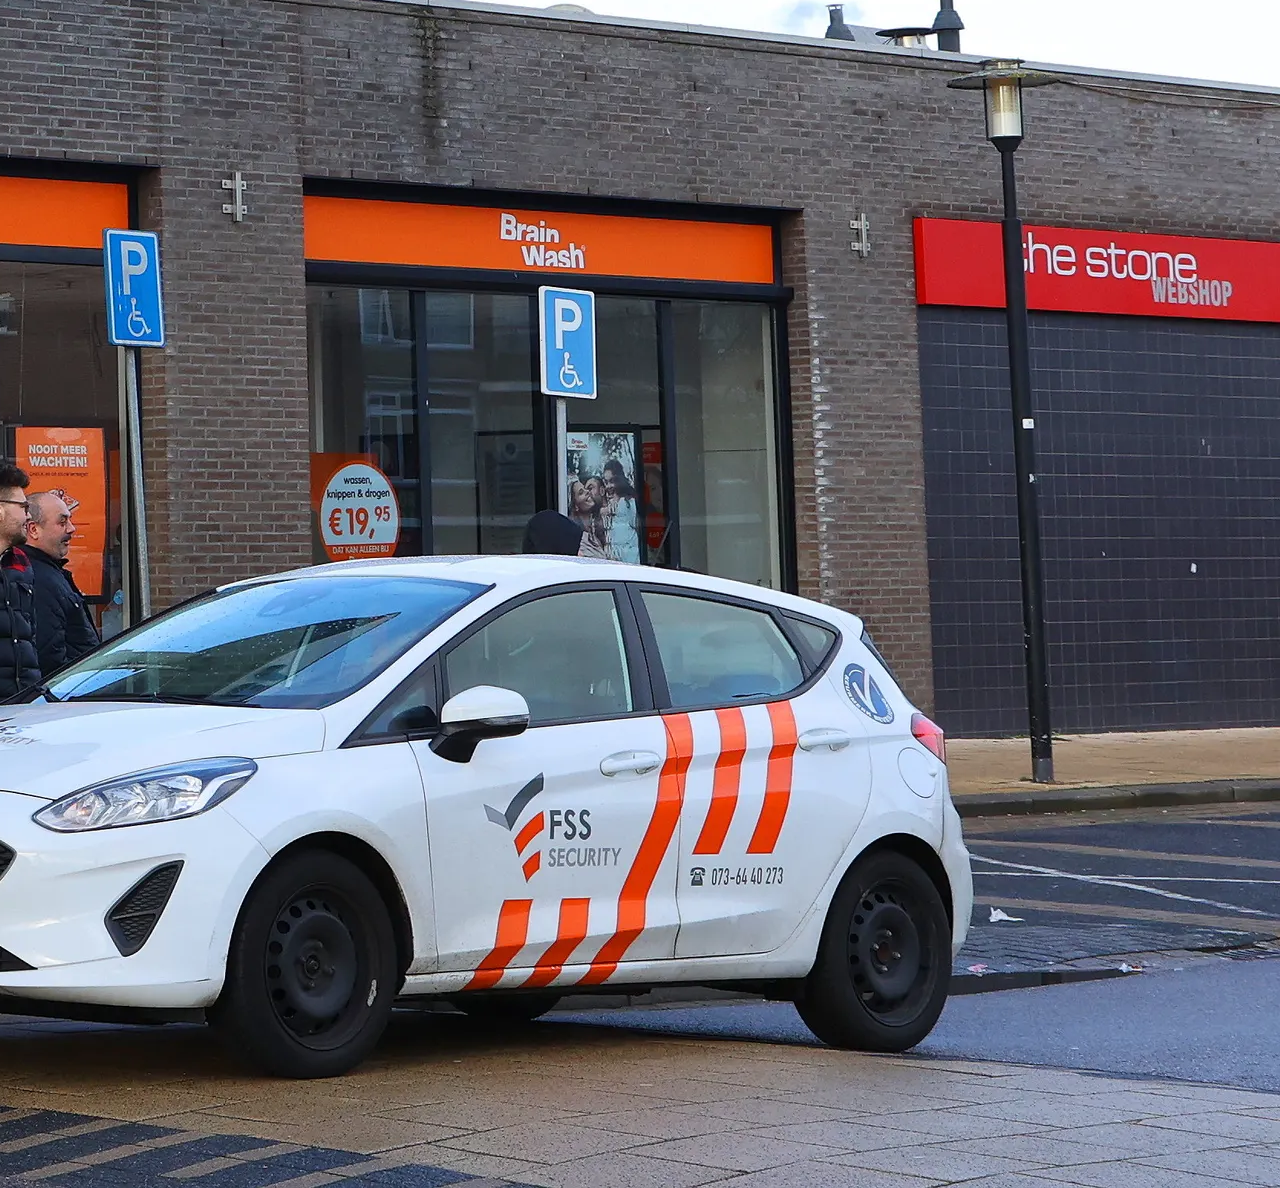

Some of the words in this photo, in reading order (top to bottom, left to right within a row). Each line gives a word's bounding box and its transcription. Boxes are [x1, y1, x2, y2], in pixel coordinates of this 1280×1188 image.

[500, 212, 560, 243] Brain
[120, 240, 148, 296] P
[521, 243, 586, 269] Wash
[1086, 242, 1198, 284] stone
[1151, 276, 1233, 307] WEBSHOP
[554, 298, 583, 350] P
[28, 444, 58, 454] NOOIT
[60, 445, 87, 455] MEER
[29, 456, 88, 467] WACHTEN!
[326, 489, 355, 500] knippen
[357, 489, 363, 498] &
[365, 488, 391, 499] drogen
[343, 477, 372, 485] wassen,
[549, 809, 592, 840] FSS
[548, 847, 622, 868] SECURITY
[711, 868, 748, 886] 073-64
[750, 867, 762, 885] 40
[765, 867, 784, 885] 273
